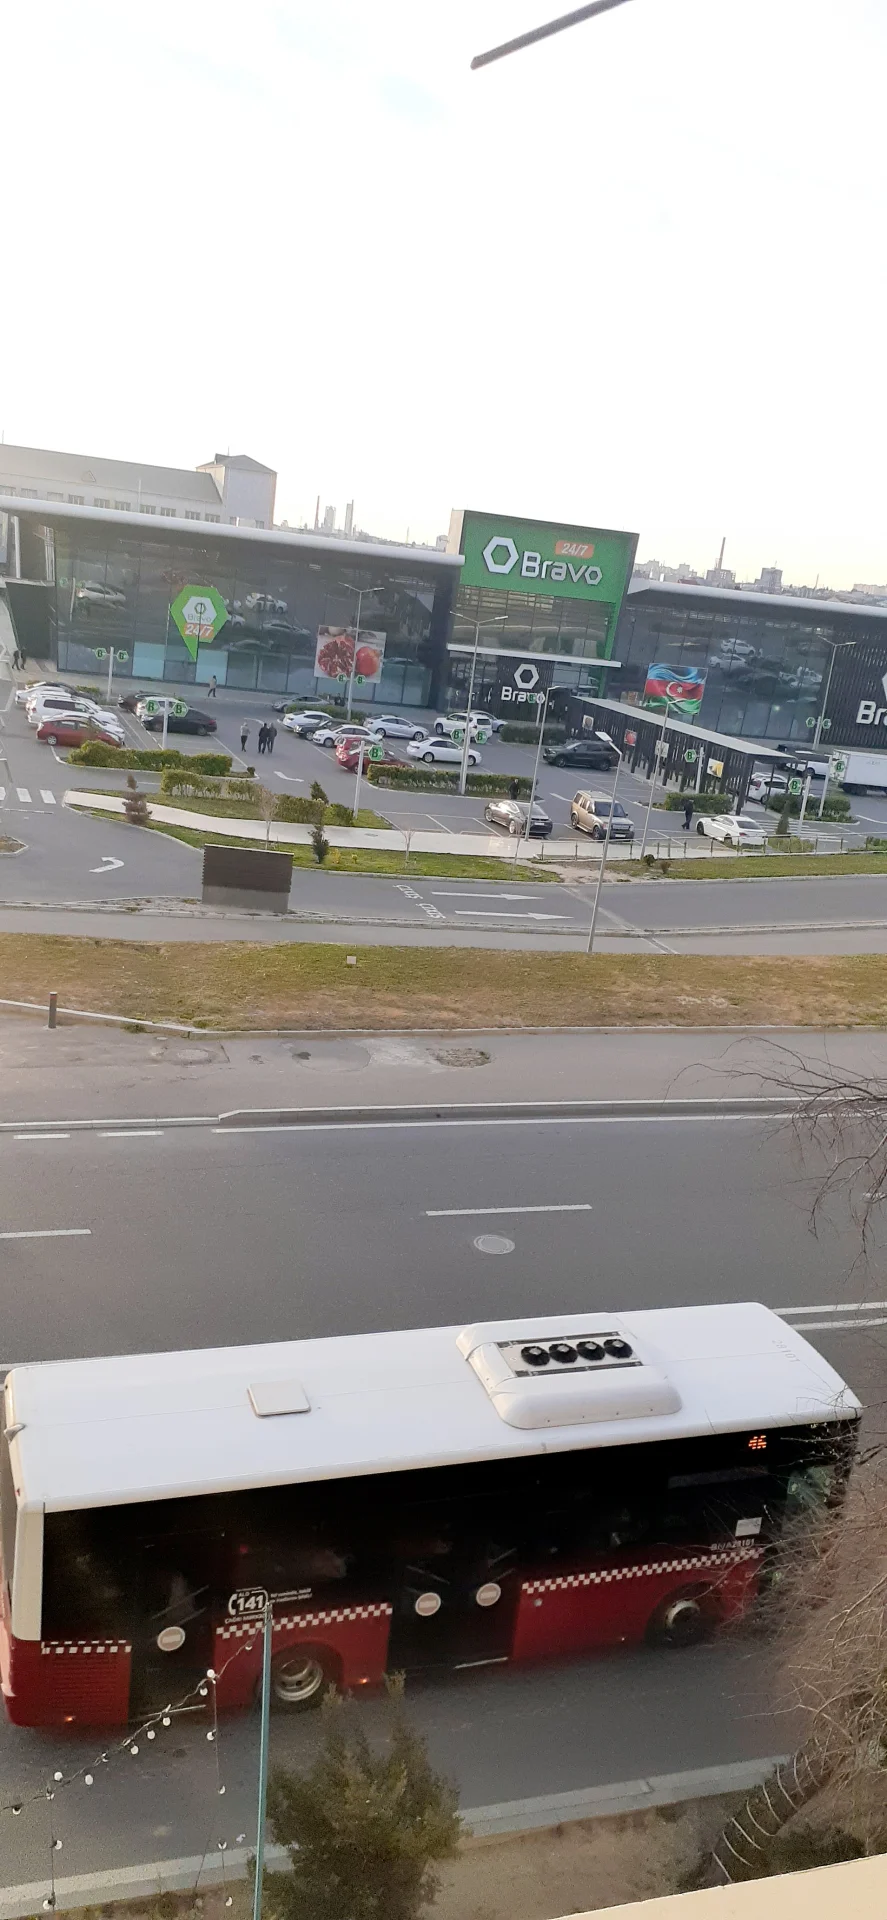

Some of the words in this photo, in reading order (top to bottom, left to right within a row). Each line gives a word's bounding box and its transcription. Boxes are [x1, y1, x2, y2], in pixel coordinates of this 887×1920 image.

[561, 543, 588, 556] 24/7
[521, 551, 603, 585] Bravo
[184, 624, 214, 637] 24/7
[501, 686, 545, 704] Brao
[856, 700, 887, 725] Br
[237, 1595, 264, 1611] 141
